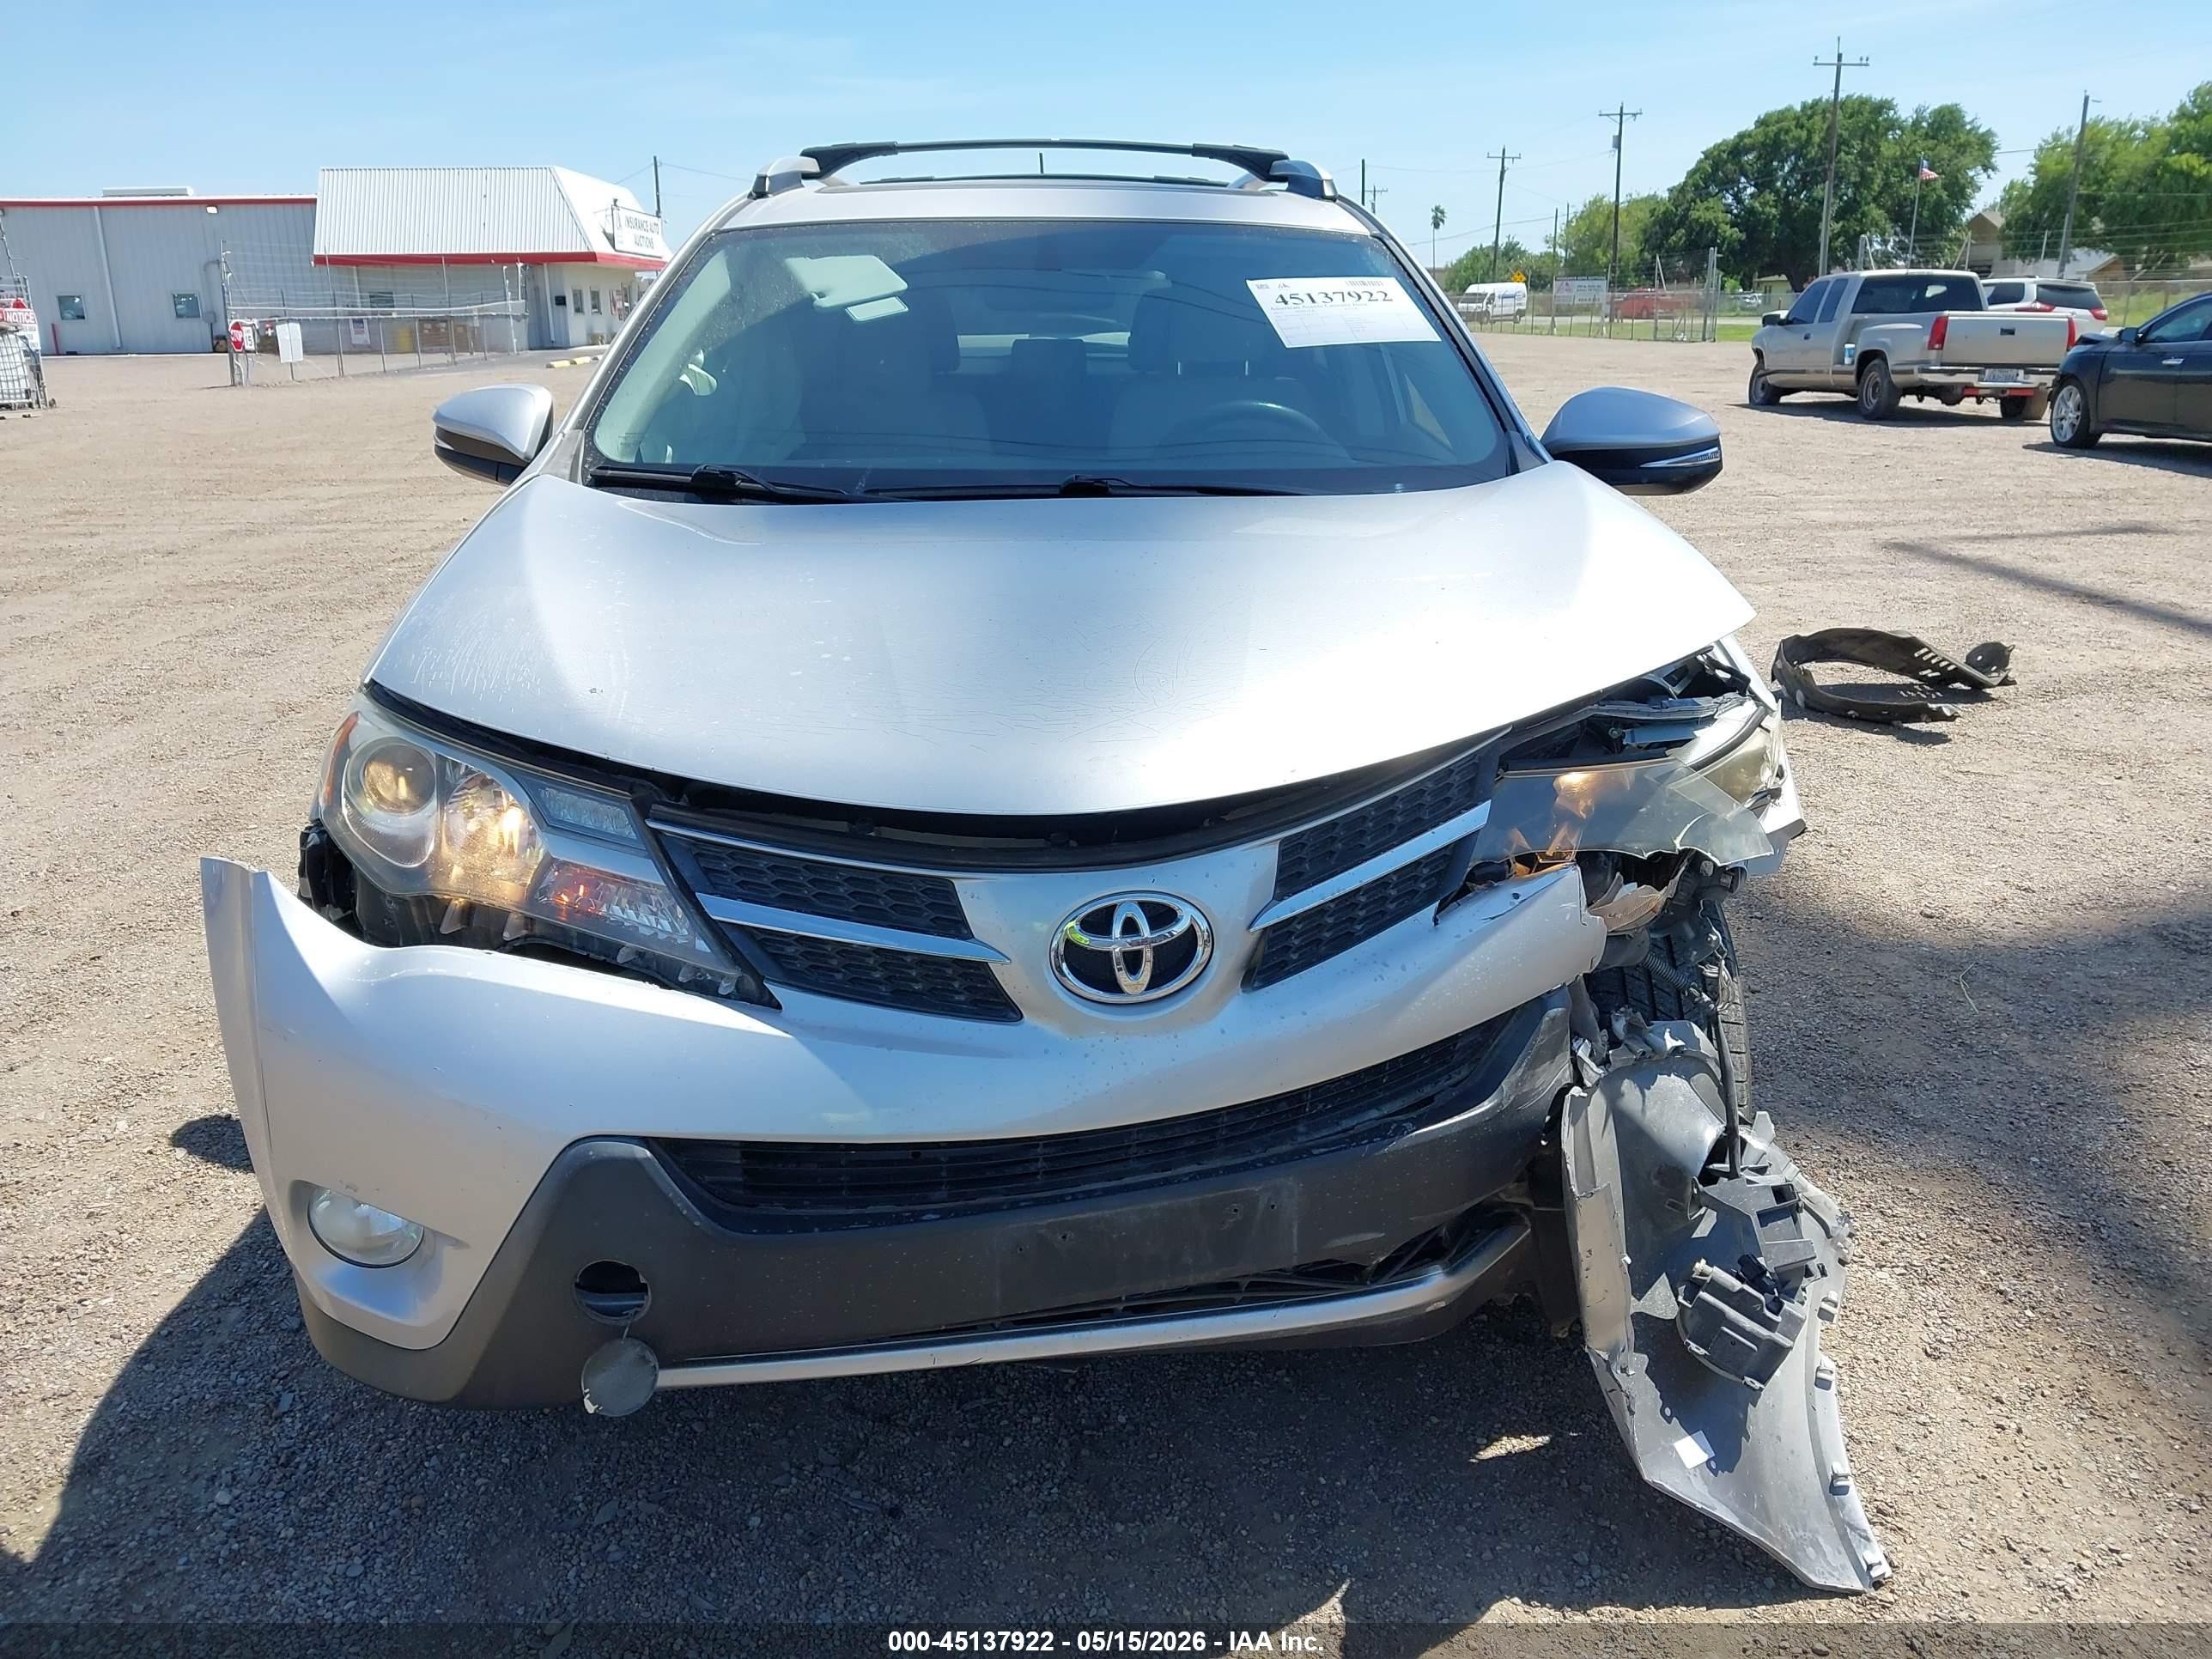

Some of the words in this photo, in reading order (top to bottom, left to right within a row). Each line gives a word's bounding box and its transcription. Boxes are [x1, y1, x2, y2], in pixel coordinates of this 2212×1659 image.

[625, 216, 648, 233] INSURANCE
[1275, 291, 1393, 306] 45137922
[6, 312, 35, 324] NOTICE
[230, 329, 243, 342] STOP
